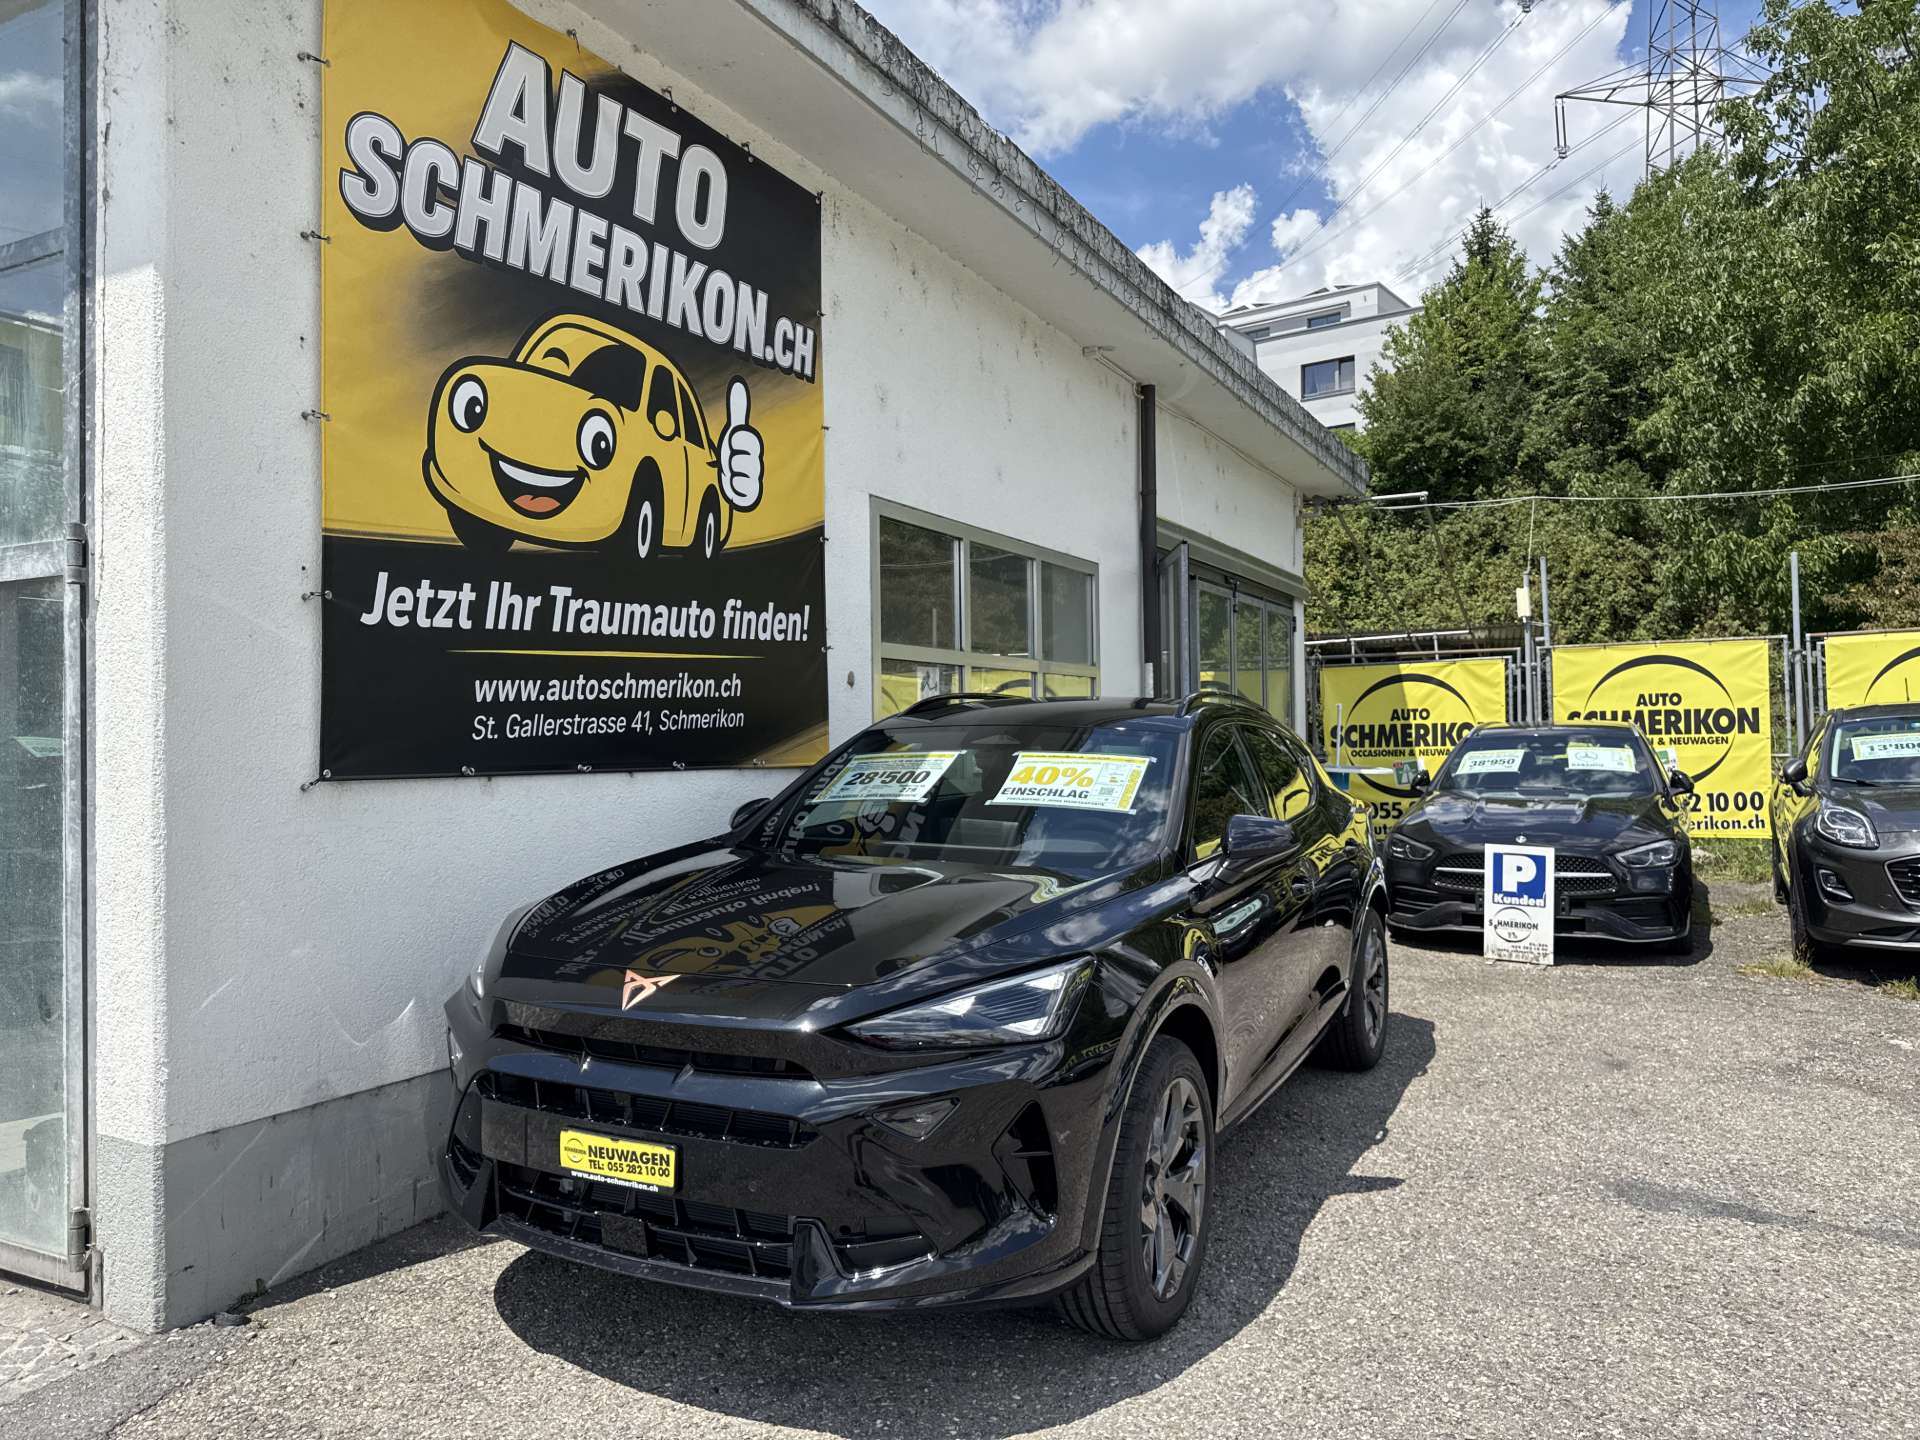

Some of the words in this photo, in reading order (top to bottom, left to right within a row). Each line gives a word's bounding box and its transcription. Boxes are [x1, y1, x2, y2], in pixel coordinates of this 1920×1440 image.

[472, 39, 728, 250] AUTO
[339, 111, 816, 380] SCHMERIKON.CH
[360, 571, 476, 630] Jetzt
[484, 581, 542, 632] Ihr
[549, 585, 716, 640] Traumauto
[722, 597, 811, 642] finden!
[474, 671, 743, 704] www.autoschmerikon.ch
[1636, 692, 1682, 707] AUTO
[471, 715, 499, 740] St.
[505, 711, 627, 739] Gallerstrasse
[631, 711, 654, 736] 41,
[659, 708, 745, 732] Schmerikon
[1390, 708, 1431, 722] AUTO
[1330, 721, 1482, 749] SCHMERIKO
[1657, 737, 1666, 746] &
[1669, 736, 1729, 746] NEUWAGEN
[1351, 749, 1406, 758] OCCASIONEN
[1409, 749, 1415, 757] &
[1419, 749, 1450, 757] NEUWA
[1868, 742, 1920, 752] 13'80
[843, 770, 932, 786] 28'500
[1010, 765, 1094, 788] 40%
[1001, 786, 1090, 800] EINSCHLAG
[1707, 792, 1730, 812] 10
[1733, 791, 1765, 812] 00
[1689, 814, 1766, 830] erikon.ch
[1502, 854, 1537, 893] P
[1493, 892, 1546, 908] Kunden
[1488, 918, 1539, 931] SHMERIKON
[587, 1144, 671, 1167] NEUWAGEN
[588, 1159, 605, 1171] TEL:
[607, 1161, 624, 1173] 055
[626, 1163, 643, 1175] 282
[645, 1165, 656, 1177] 10
[658, 1167, 671, 1178] 00
[570, 1169, 659, 1193] www.auto-schmerikon.ch
